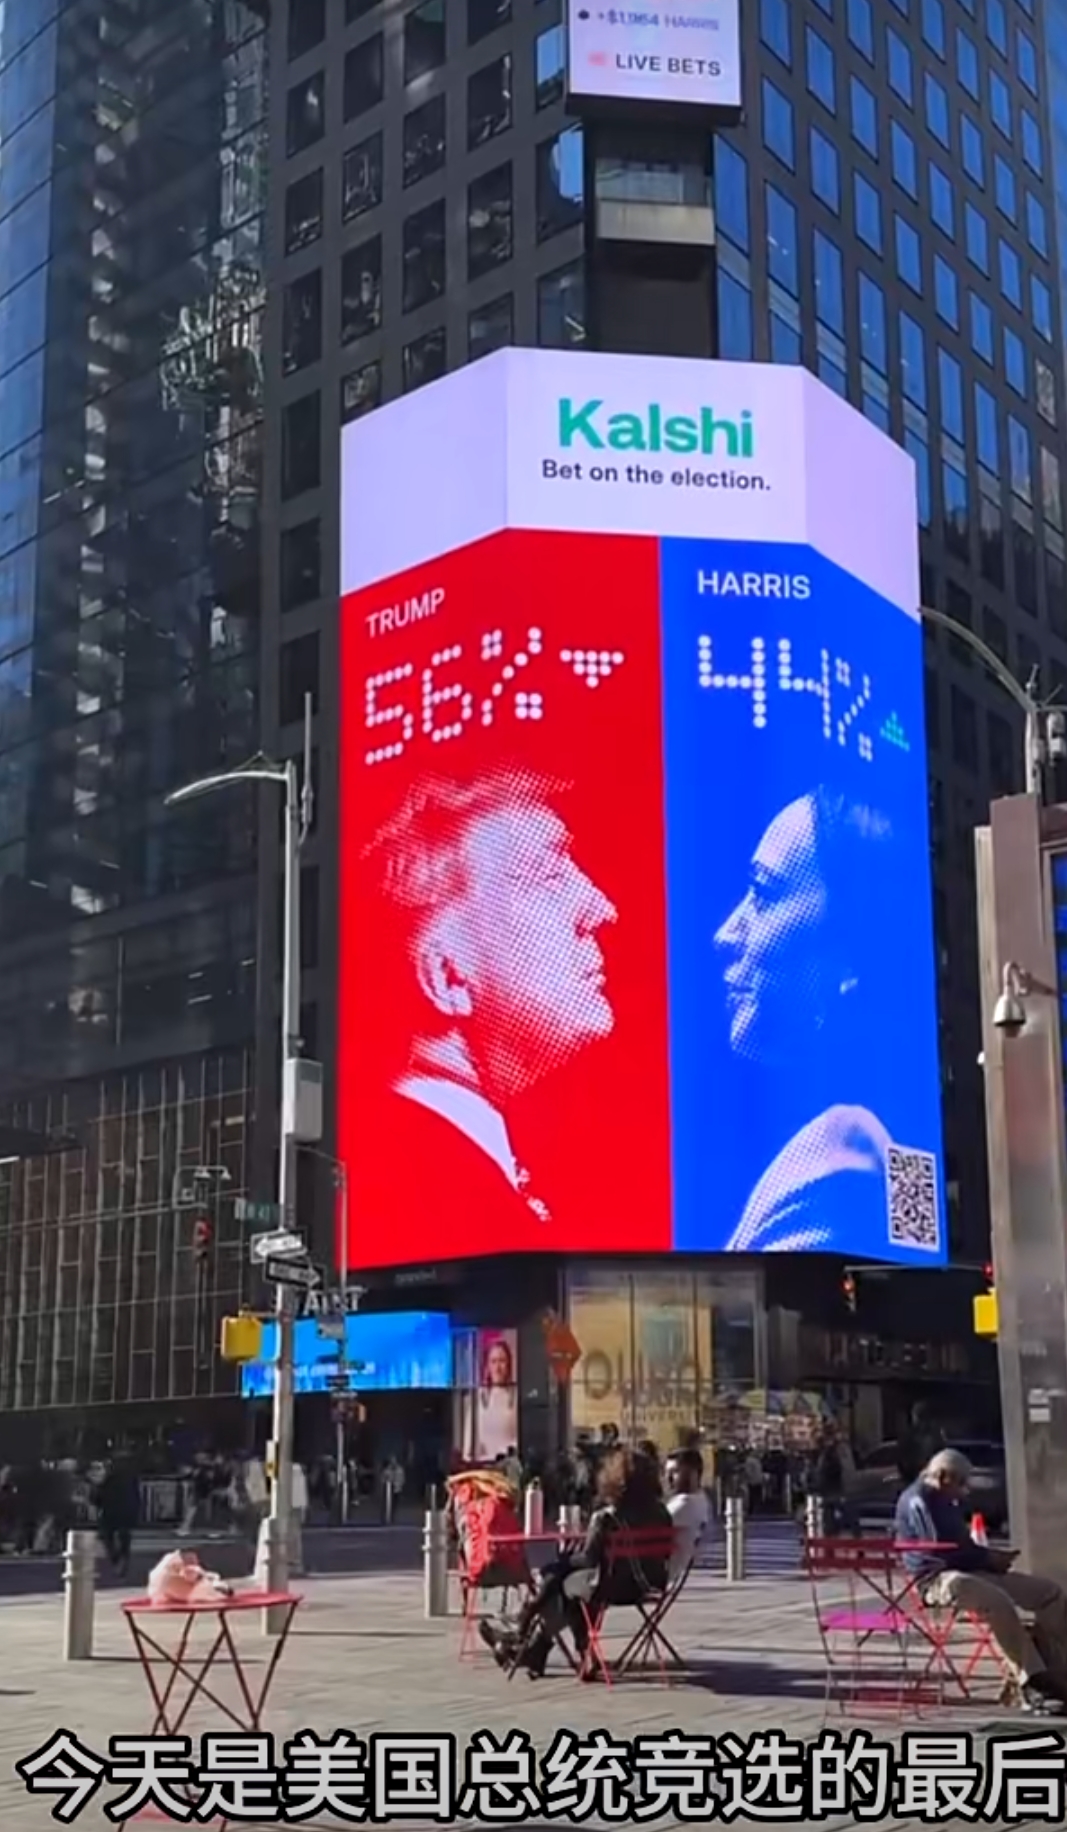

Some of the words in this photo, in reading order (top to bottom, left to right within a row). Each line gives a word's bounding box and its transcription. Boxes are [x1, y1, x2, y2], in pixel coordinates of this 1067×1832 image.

[615, 54, 661, 72] LIVE
[667, 58, 721, 77] BETS
[558, 397, 754, 458] Kalshi
[542, 459, 583, 480] Bet
[589, 466, 618, 482] on
[626, 464, 664, 485] the
[671, 468, 772, 491] election.
[698, 570, 811, 599] HARRIS
[365, 587, 445, 638] TRUMP
[365, 626, 543, 765] 56%
[698, 634, 873, 762] 44%
